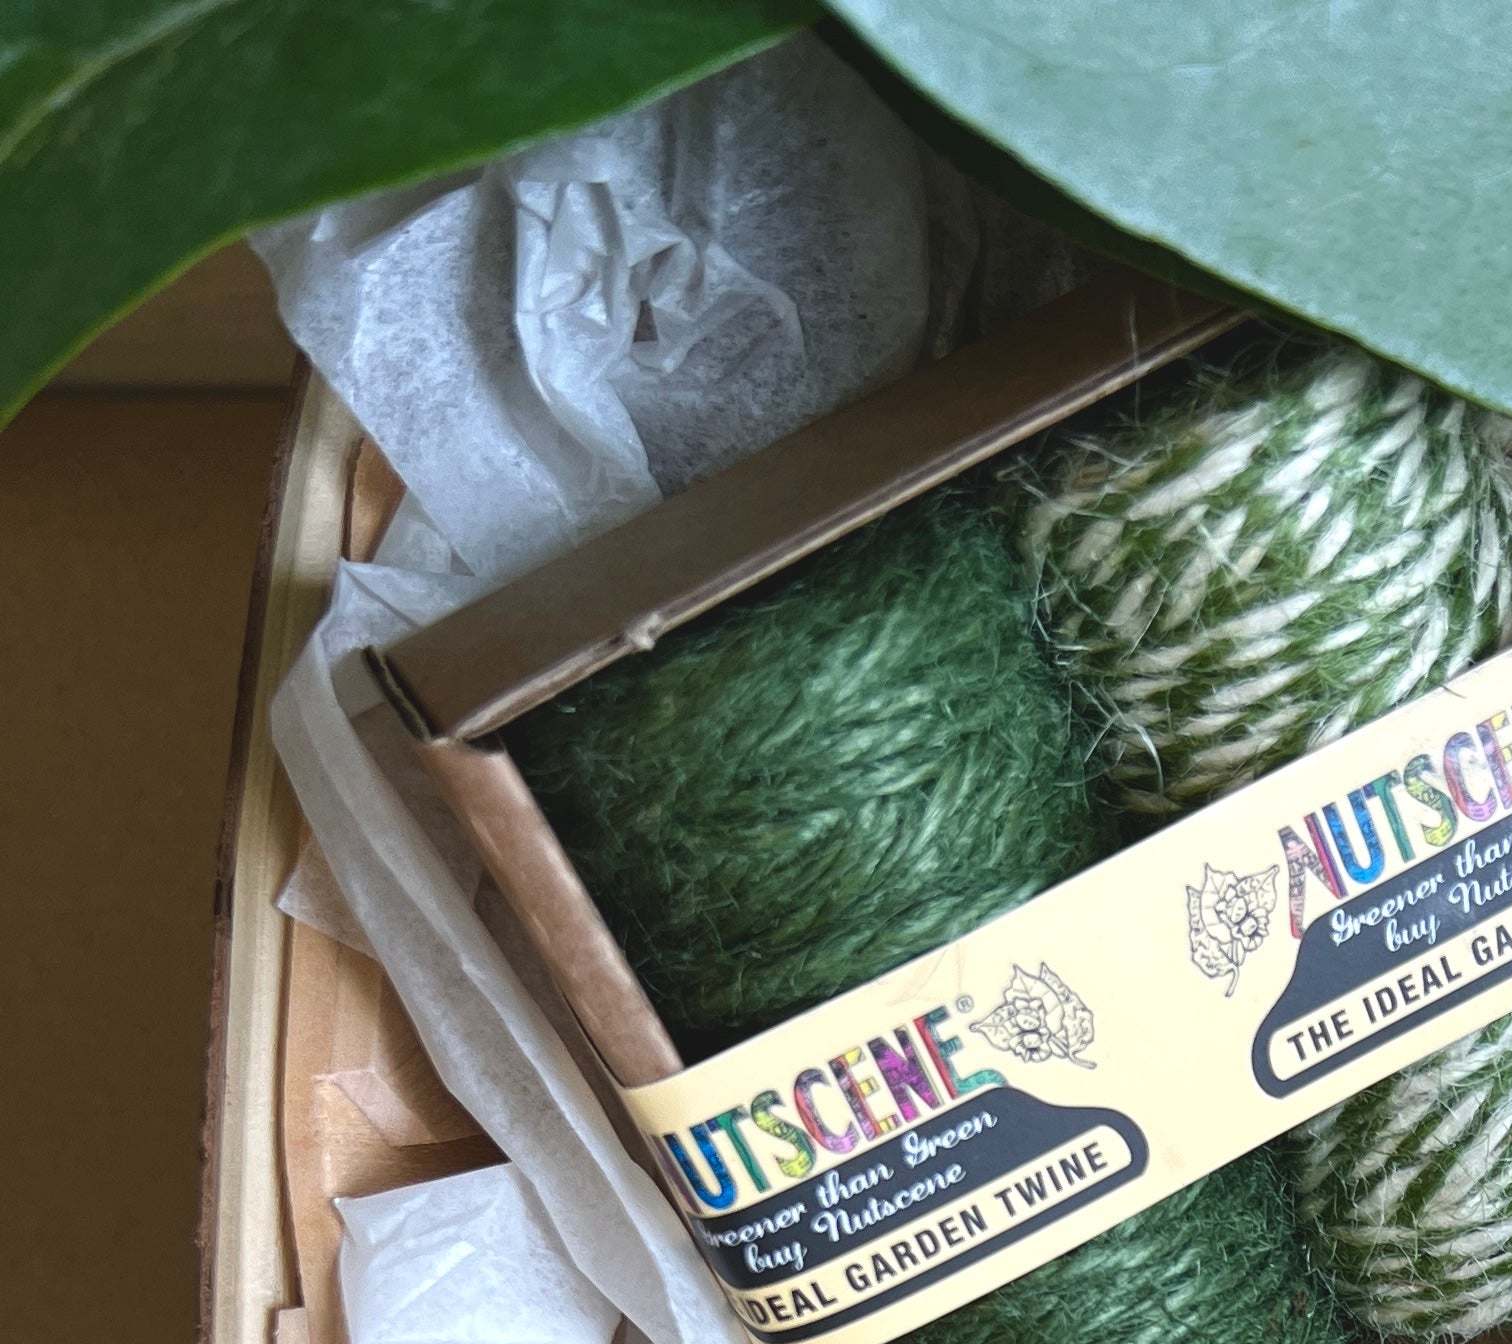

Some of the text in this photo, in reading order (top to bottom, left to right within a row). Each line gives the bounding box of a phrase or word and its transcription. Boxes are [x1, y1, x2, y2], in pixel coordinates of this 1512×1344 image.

[1329, 874, 1446, 947] Greener
[1385, 917, 1441, 952] buy
[1286, 1010, 1354, 1063] THE
[1361, 955, 1463, 1026] IDEAL
[652, 1004, 1008, 1214] UTSCENE
[814, 1169, 894, 1208] than
[902, 1110, 998, 1169] Green
[744, 1163, 967, 1274] buy Nutscene
[844, 1204, 989, 1293] GARDEN
[994, 1141, 1109, 1218] TWINE
